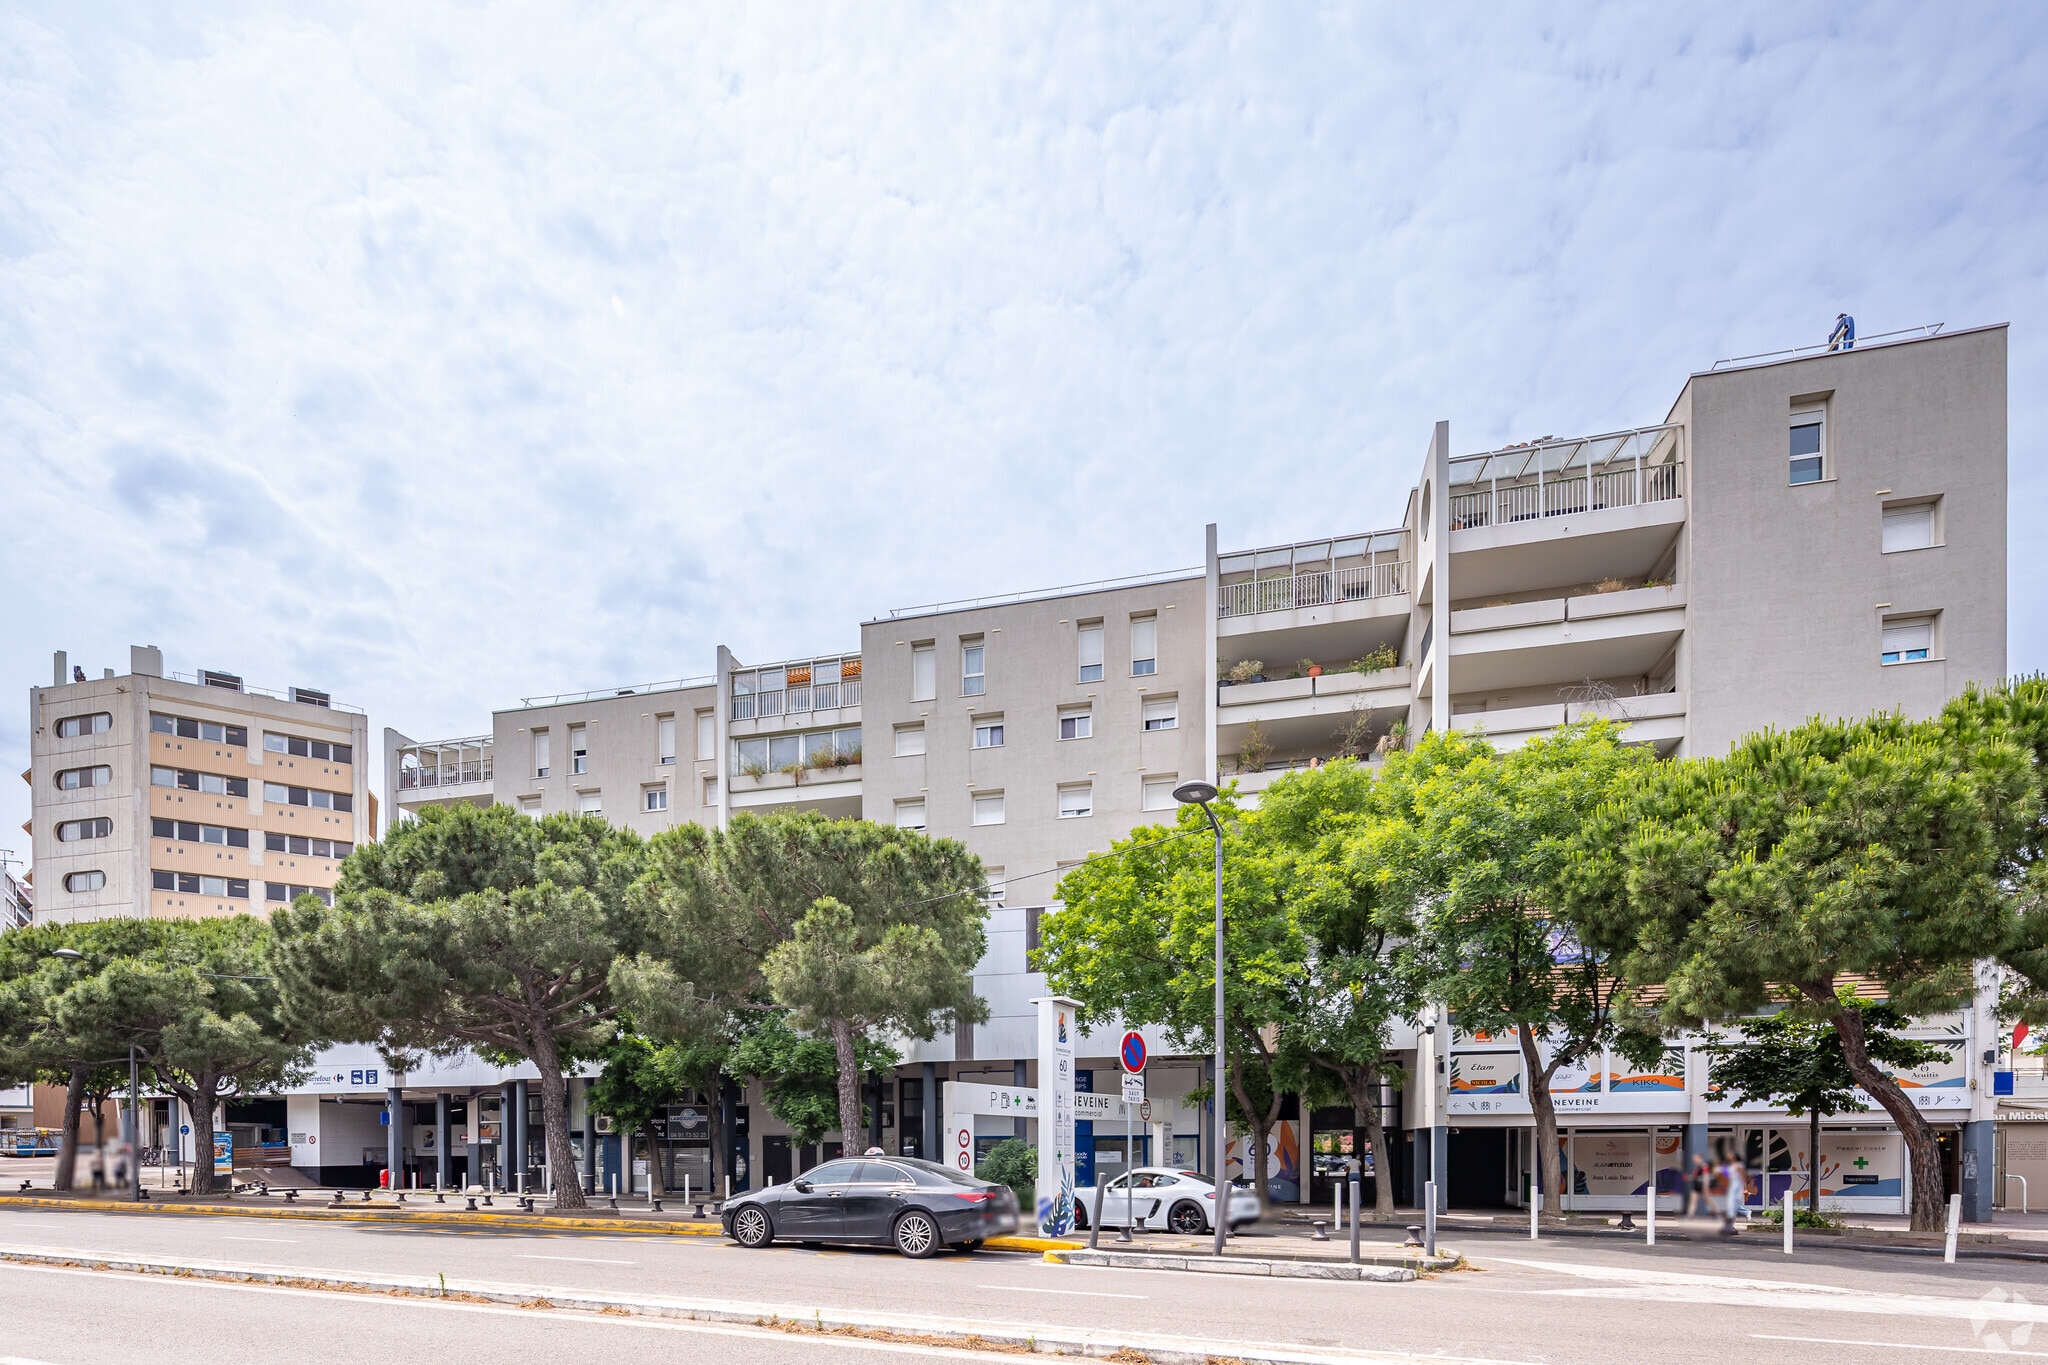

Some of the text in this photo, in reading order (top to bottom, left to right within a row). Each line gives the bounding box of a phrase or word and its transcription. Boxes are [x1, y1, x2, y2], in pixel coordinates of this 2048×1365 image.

[1470, 1063, 1495, 1071] Etam
[1632, 1078, 1660, 1086] KIKO
[1075, 1095, 1109, 1108] EVEINE
[1554, 1098, 1599, 1106] NEVEINE
[1025, 1103, 1037, 1111] drive
[1075, 1110, 1102, 1118] commercial
[1993, 1113, 2006, 1121] an
[961, 1156, 968, 1165] 10
